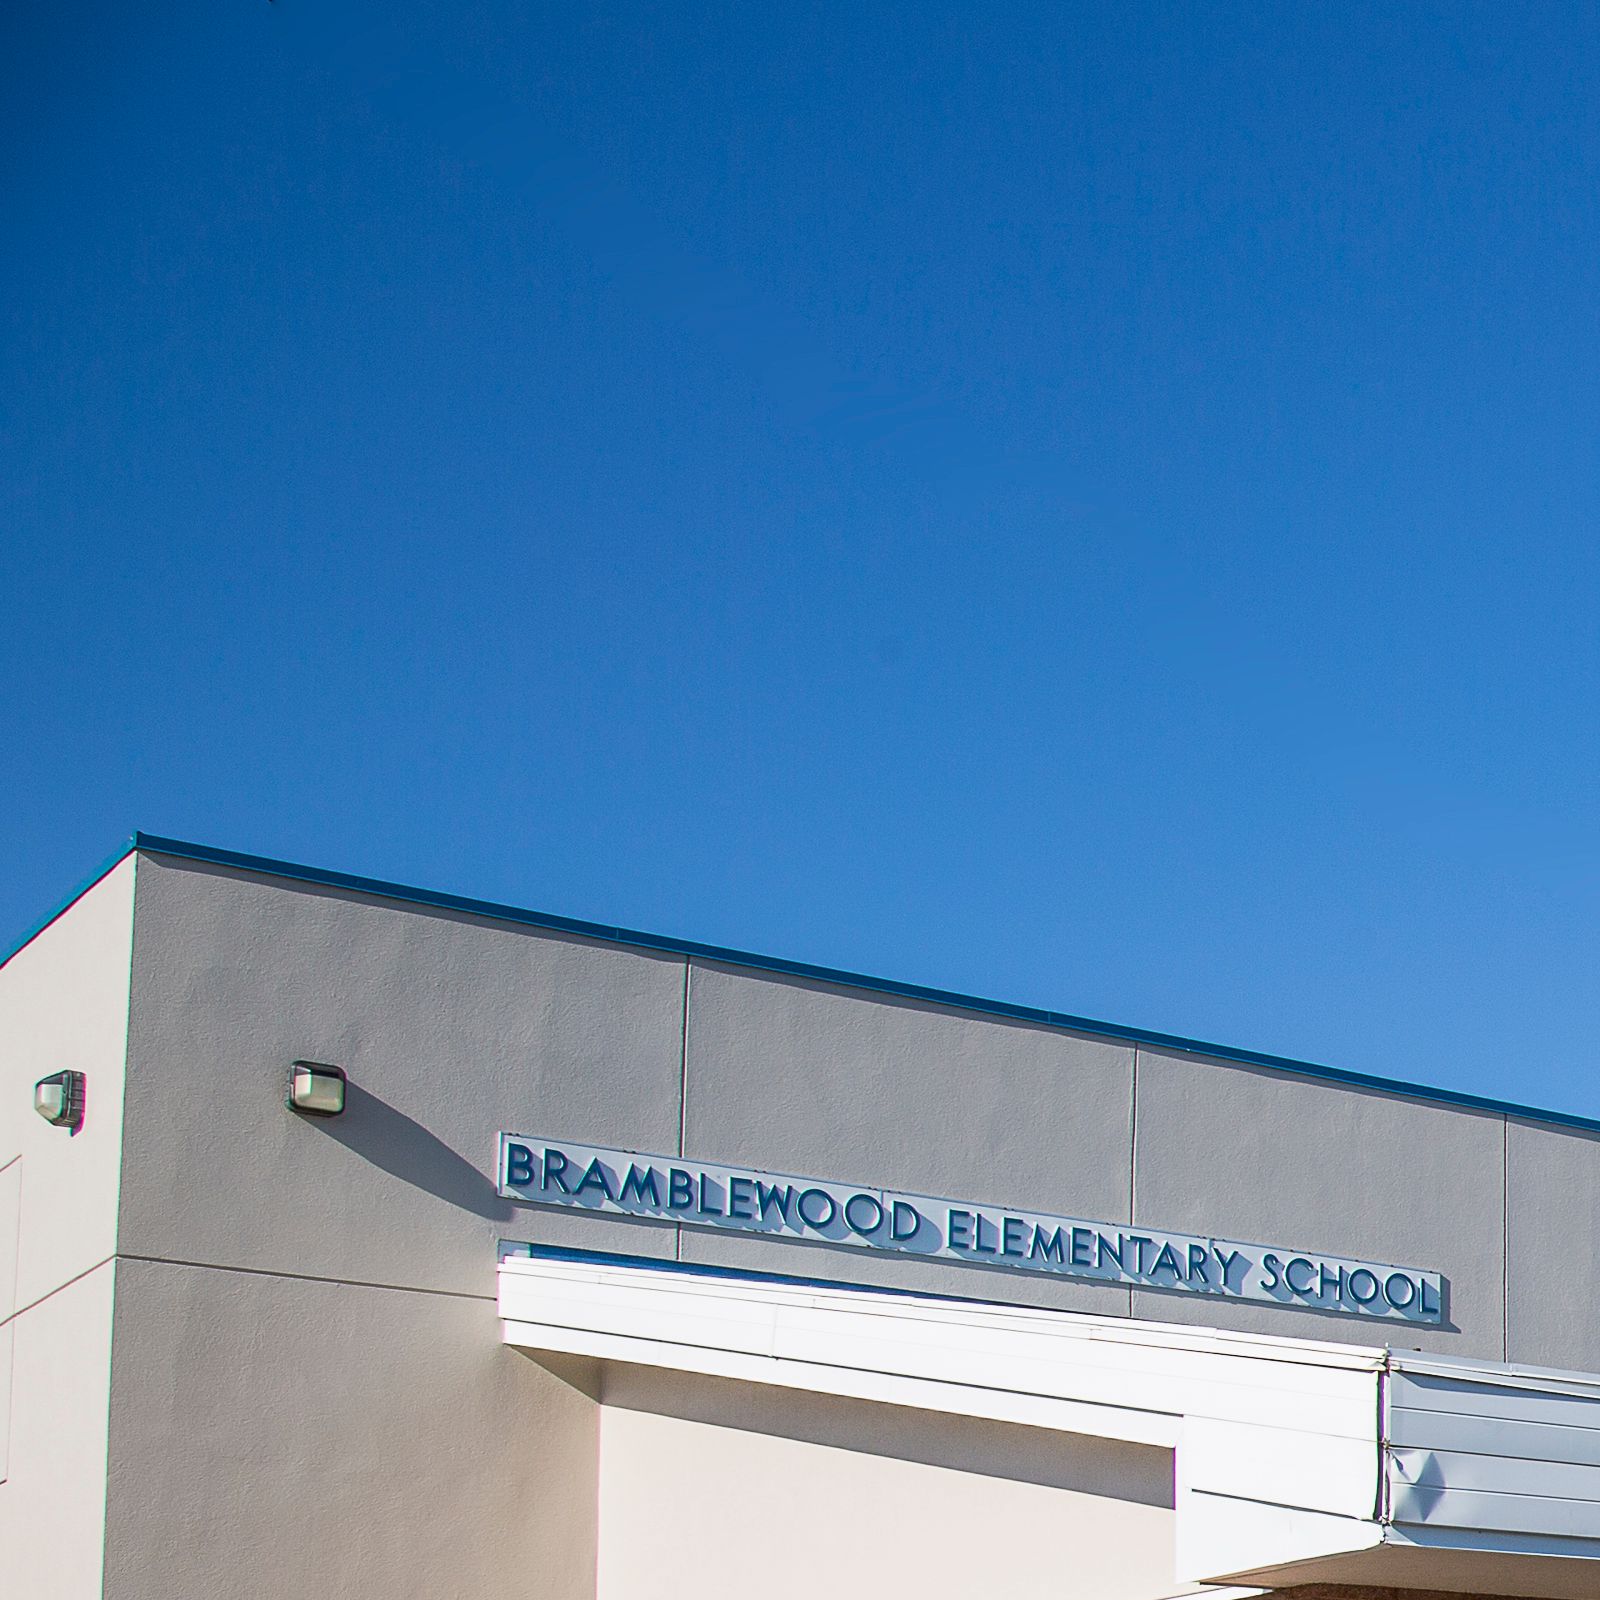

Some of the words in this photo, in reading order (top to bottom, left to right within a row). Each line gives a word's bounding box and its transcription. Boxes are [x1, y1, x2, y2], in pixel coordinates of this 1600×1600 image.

[505, 1142, 920, 1241] BRAMBLEWOOD
[946, 1208, 1239, 1287] ELEMENTARY
[1260, 1254, 1438, 1315] SCHOOL
